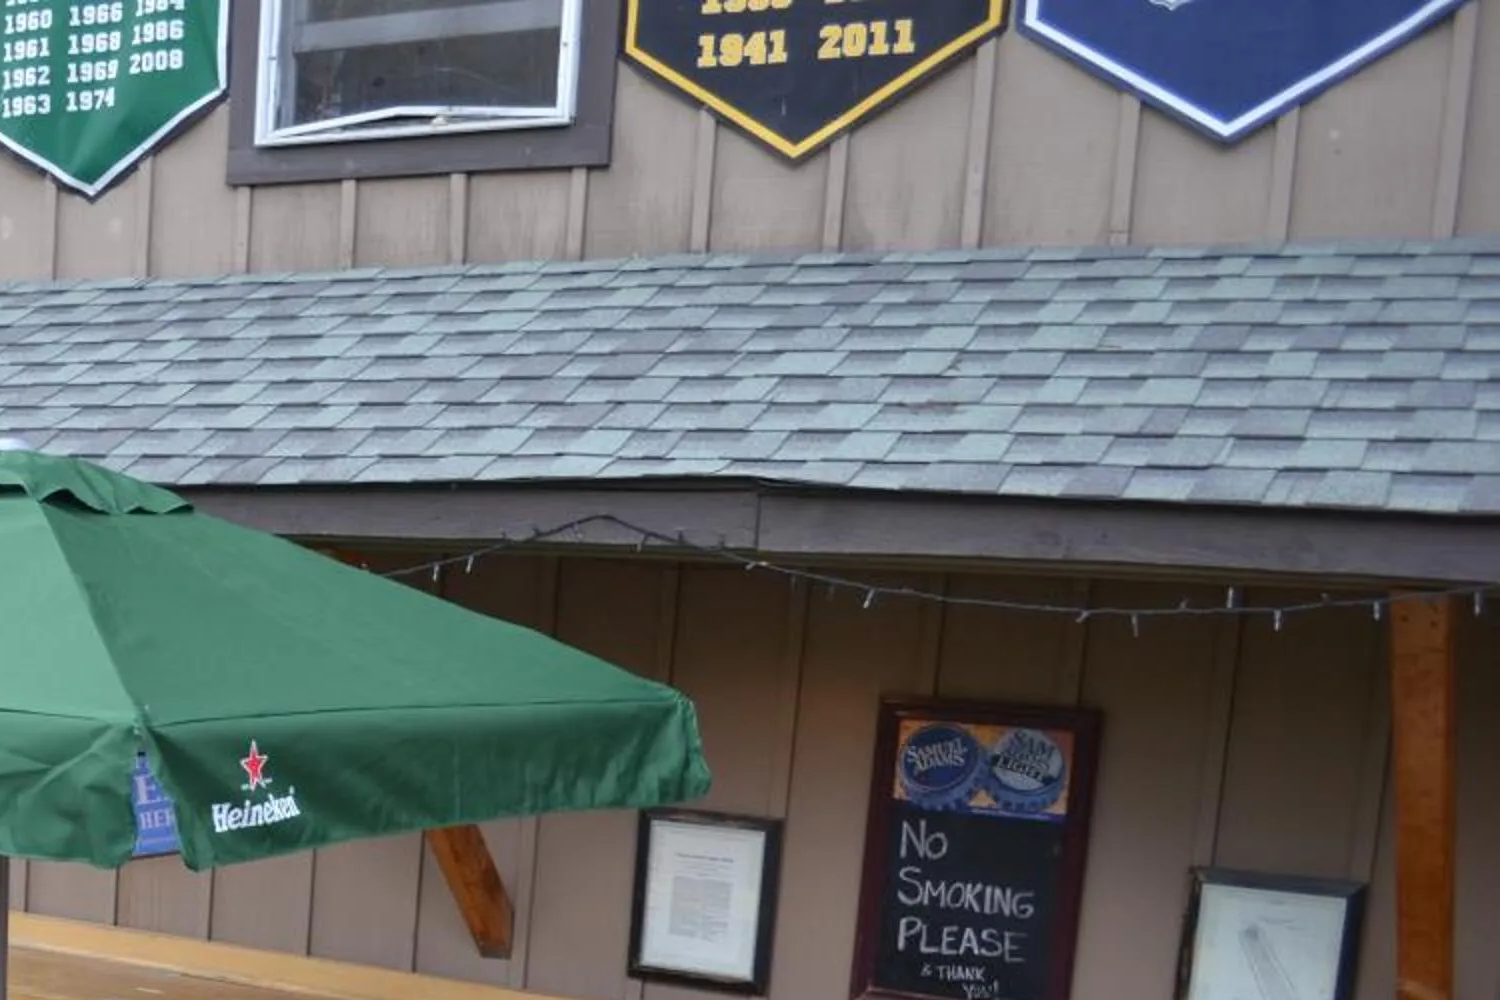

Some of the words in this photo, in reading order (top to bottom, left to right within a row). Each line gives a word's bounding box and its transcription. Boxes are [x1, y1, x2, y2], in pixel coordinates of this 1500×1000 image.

[4, 9, 53, 35] 1960
[69, 2, 123, 27] 1966
[67, 31, 121, 55] 1968
[131, 19, 185, 46] 1986
[696, 29, 788, 69] 1941
[817, 18, 916, 61] 2011
[3, 37, 50, 63] 1961
[129, 48, 183, 75] 2008
[2, 65, 51, 91] 1962
[67, 59, 119, 83] 1969
[2, 94, 51, 118] 1963
[66, 87, 116, 112] 1974
[211, 792, 301, 834] Heineken
[897, 866, 1035, 919] SMOKING
[897, 916, 1028, 963] PLEASE
[936, 963, 986, 982] THANK
